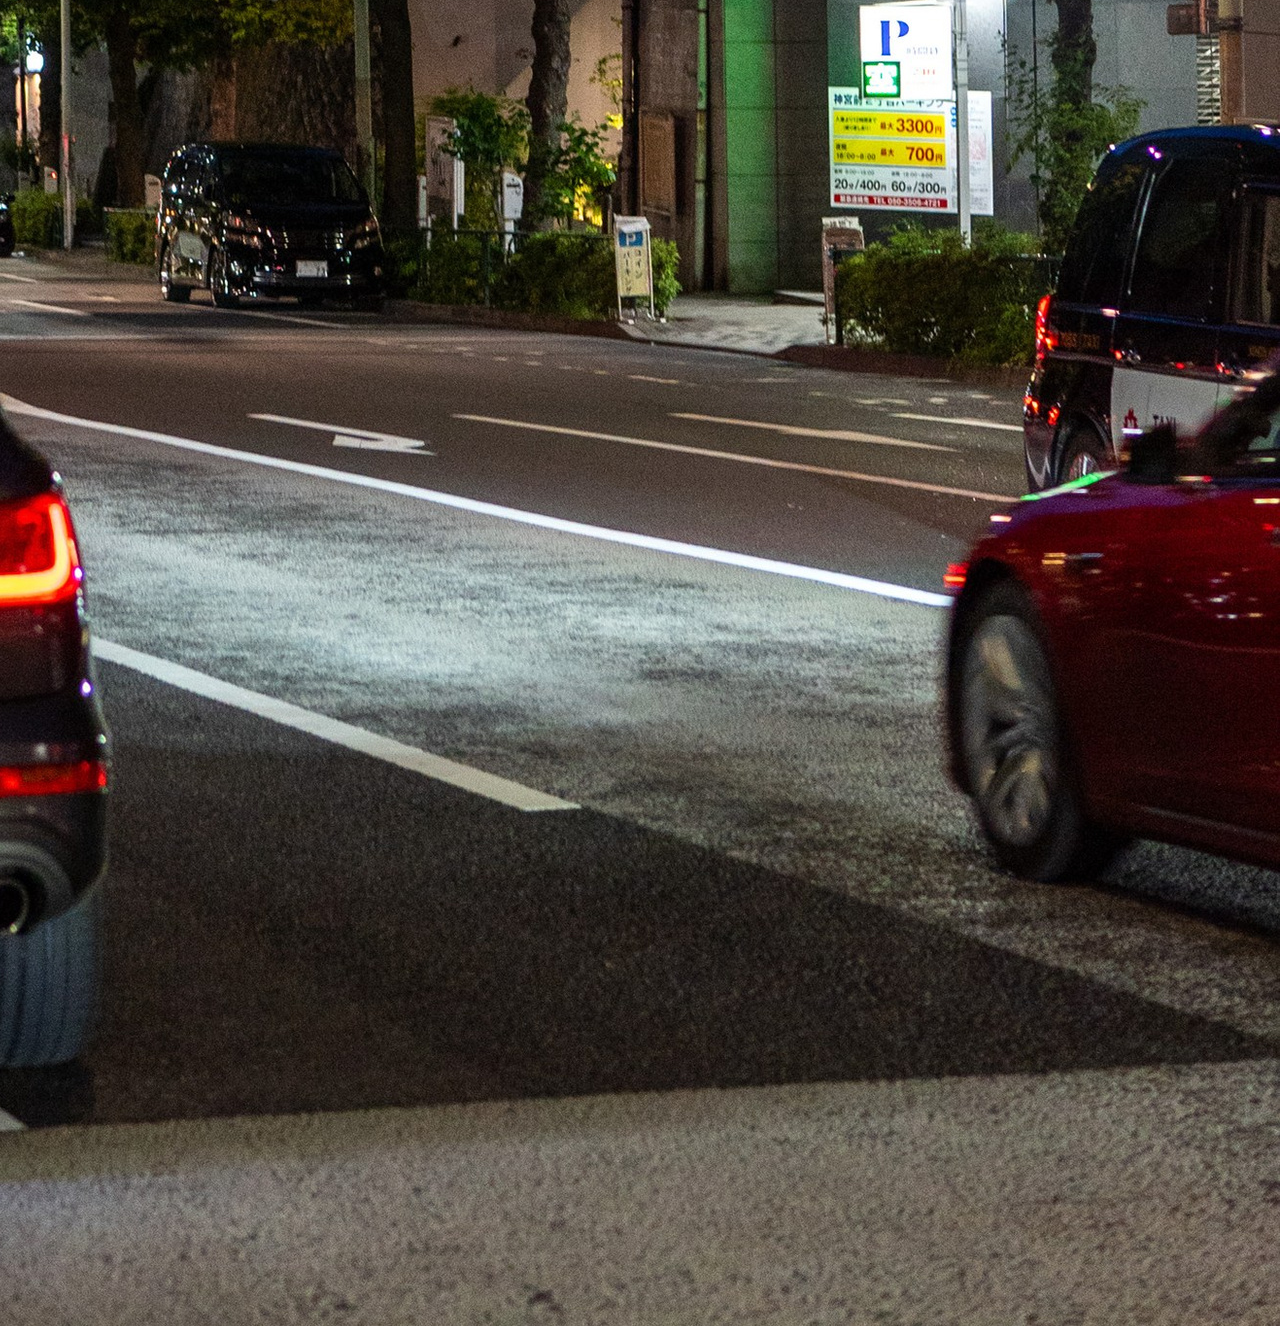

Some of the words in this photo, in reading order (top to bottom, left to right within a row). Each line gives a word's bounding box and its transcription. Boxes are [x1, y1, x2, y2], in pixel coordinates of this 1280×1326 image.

[880, 20, 910, 56] P
[896, 118, 942, 134] 3300円
[906, 146, 943, 163] 700円
[873, 196, 886, 205] TEL
[626, 233, 636, 246] P
